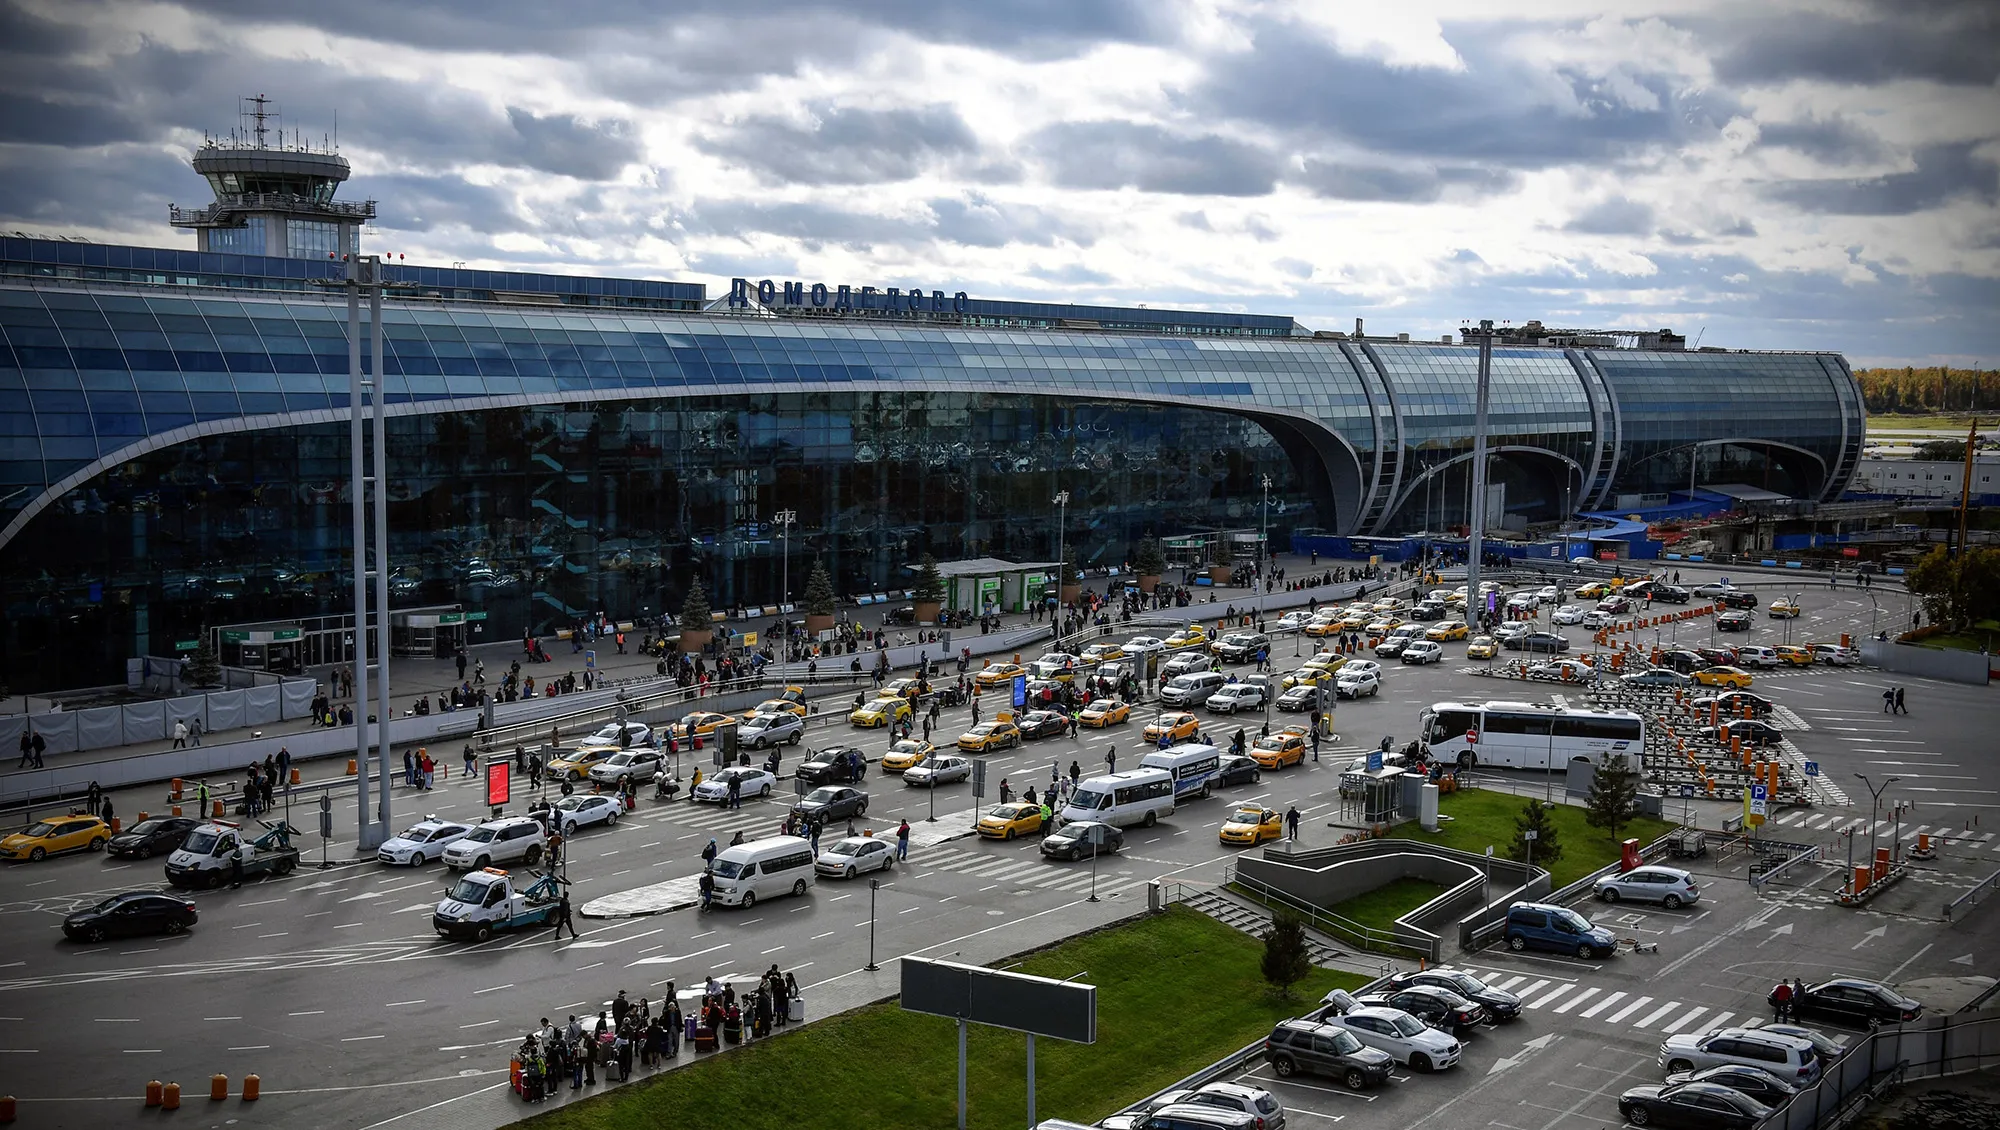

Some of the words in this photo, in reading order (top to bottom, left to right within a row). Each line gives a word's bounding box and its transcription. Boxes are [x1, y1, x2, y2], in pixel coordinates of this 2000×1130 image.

[728, 277, 968, 314] ДОМОДЕДОВО
[1754, 786, 1764, 798] P
[175, 853, 193, 863] 13
[443, 901, 464, 914] 10
